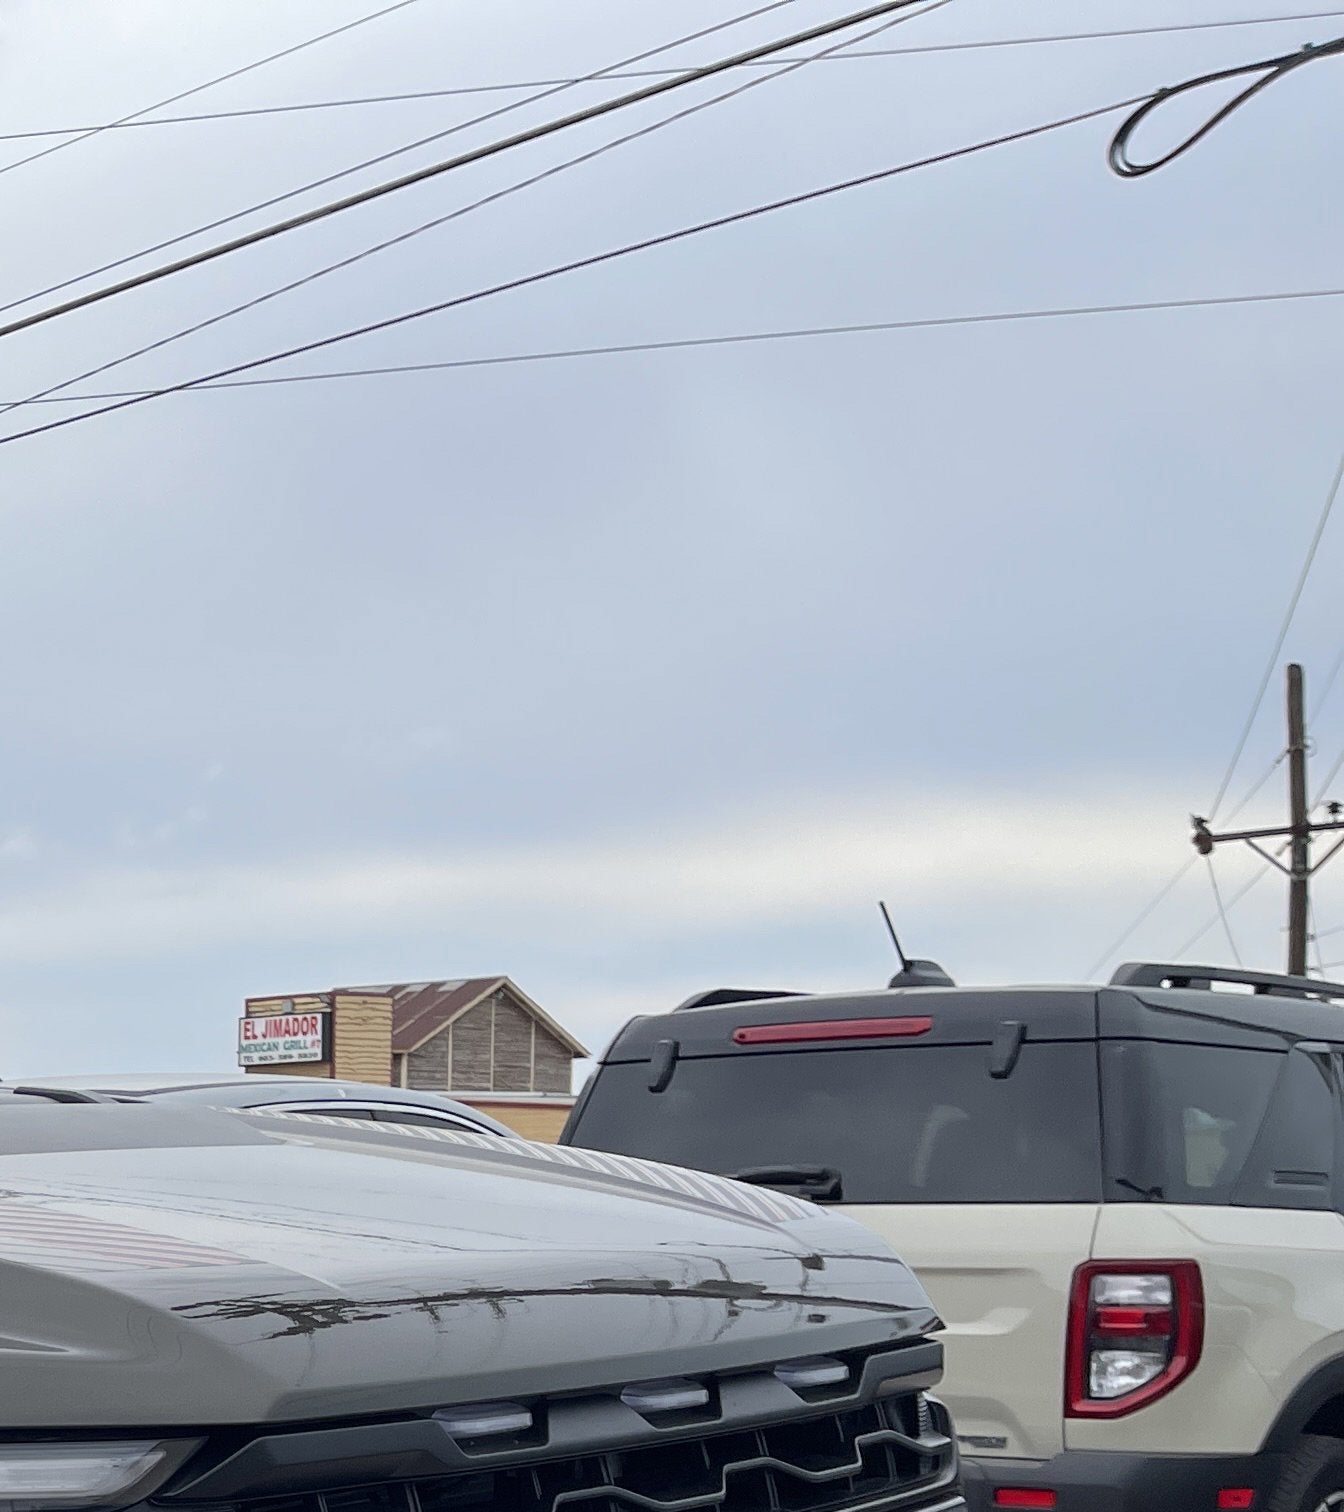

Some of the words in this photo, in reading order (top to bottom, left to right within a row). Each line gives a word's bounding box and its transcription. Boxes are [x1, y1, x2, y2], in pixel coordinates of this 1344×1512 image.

[243, 1021, 258, 1040] EL
[262, 1016, 319, 1039] JIMADOR
[241, 1041, 280, 1054] MEXICAN
[283, 1039, 308, 1050] GRILL
